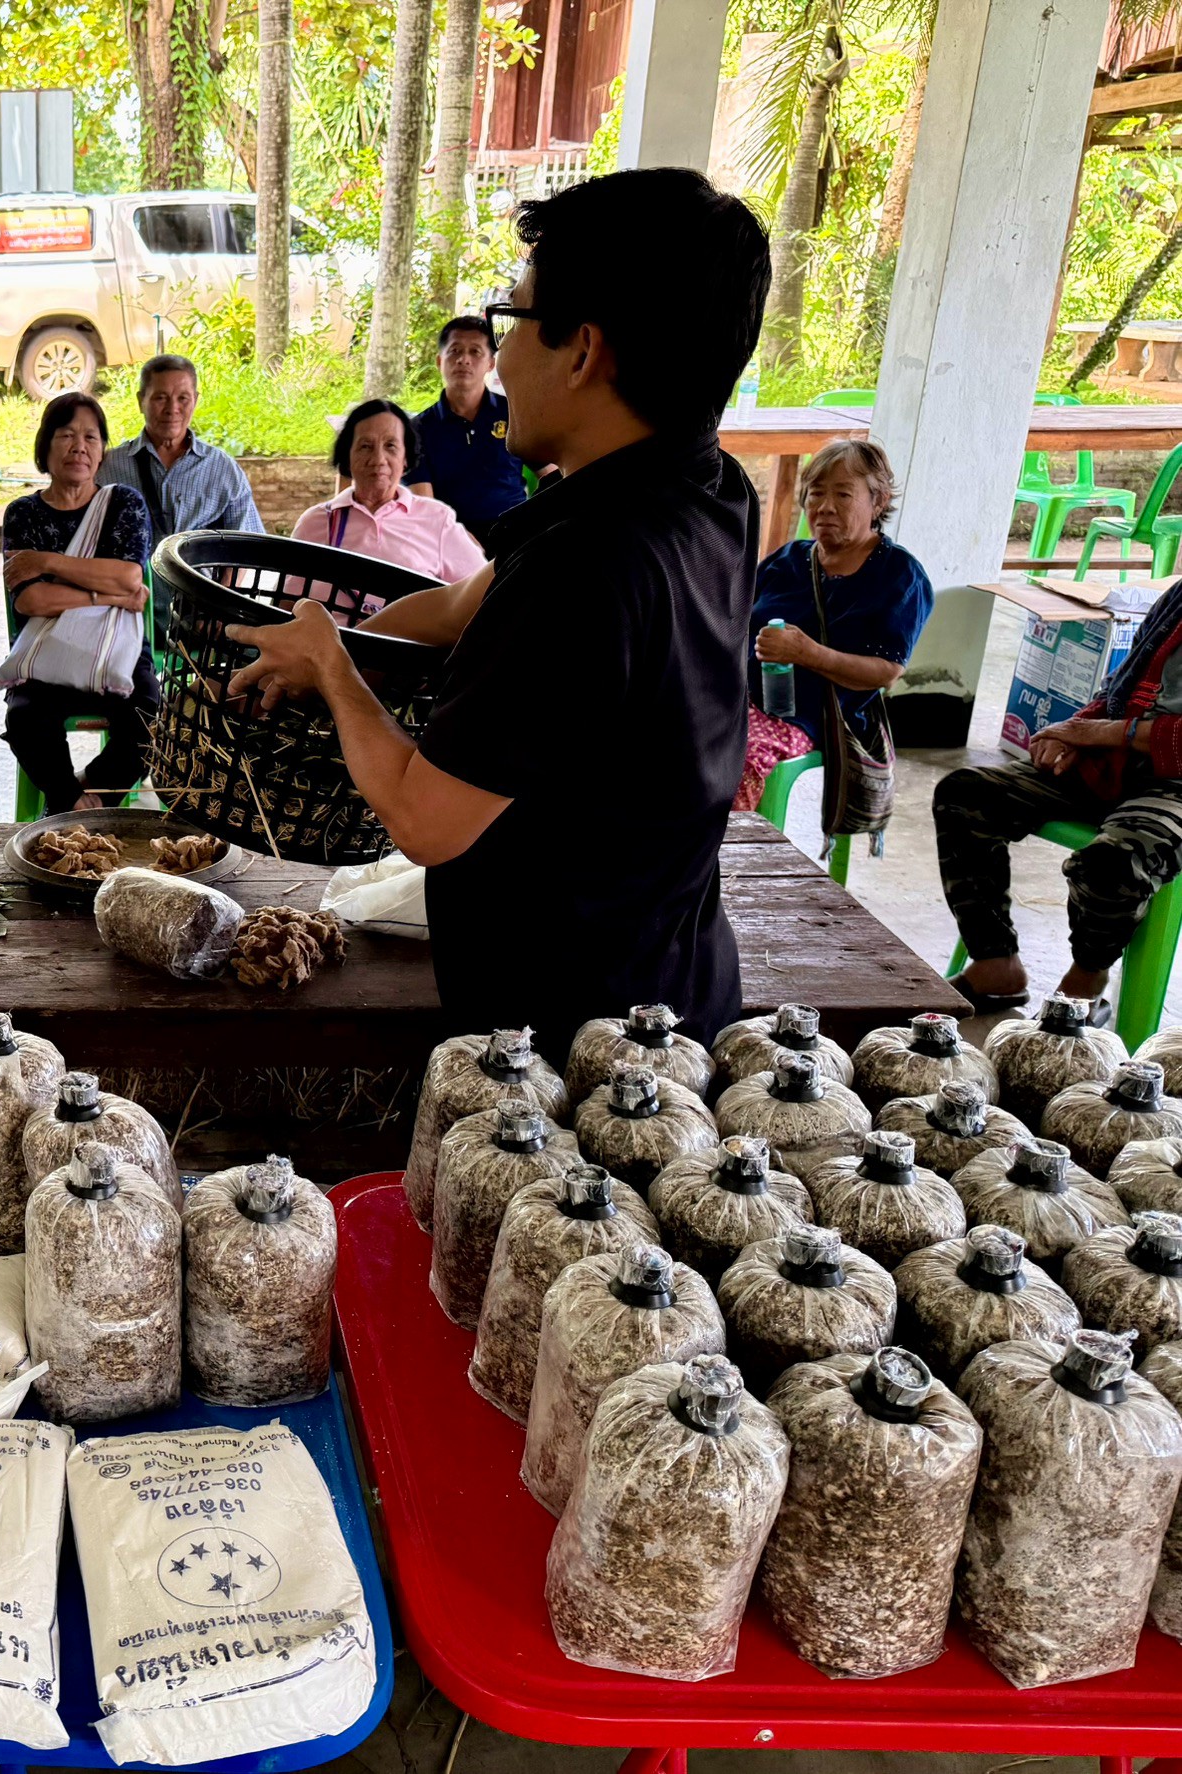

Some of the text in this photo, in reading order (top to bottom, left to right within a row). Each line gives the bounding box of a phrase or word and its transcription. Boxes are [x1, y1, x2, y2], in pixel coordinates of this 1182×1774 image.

[136, 1477, 261, 1502] 036-377748
[164, 1497, 246, 1522] เจ้ล้วง
